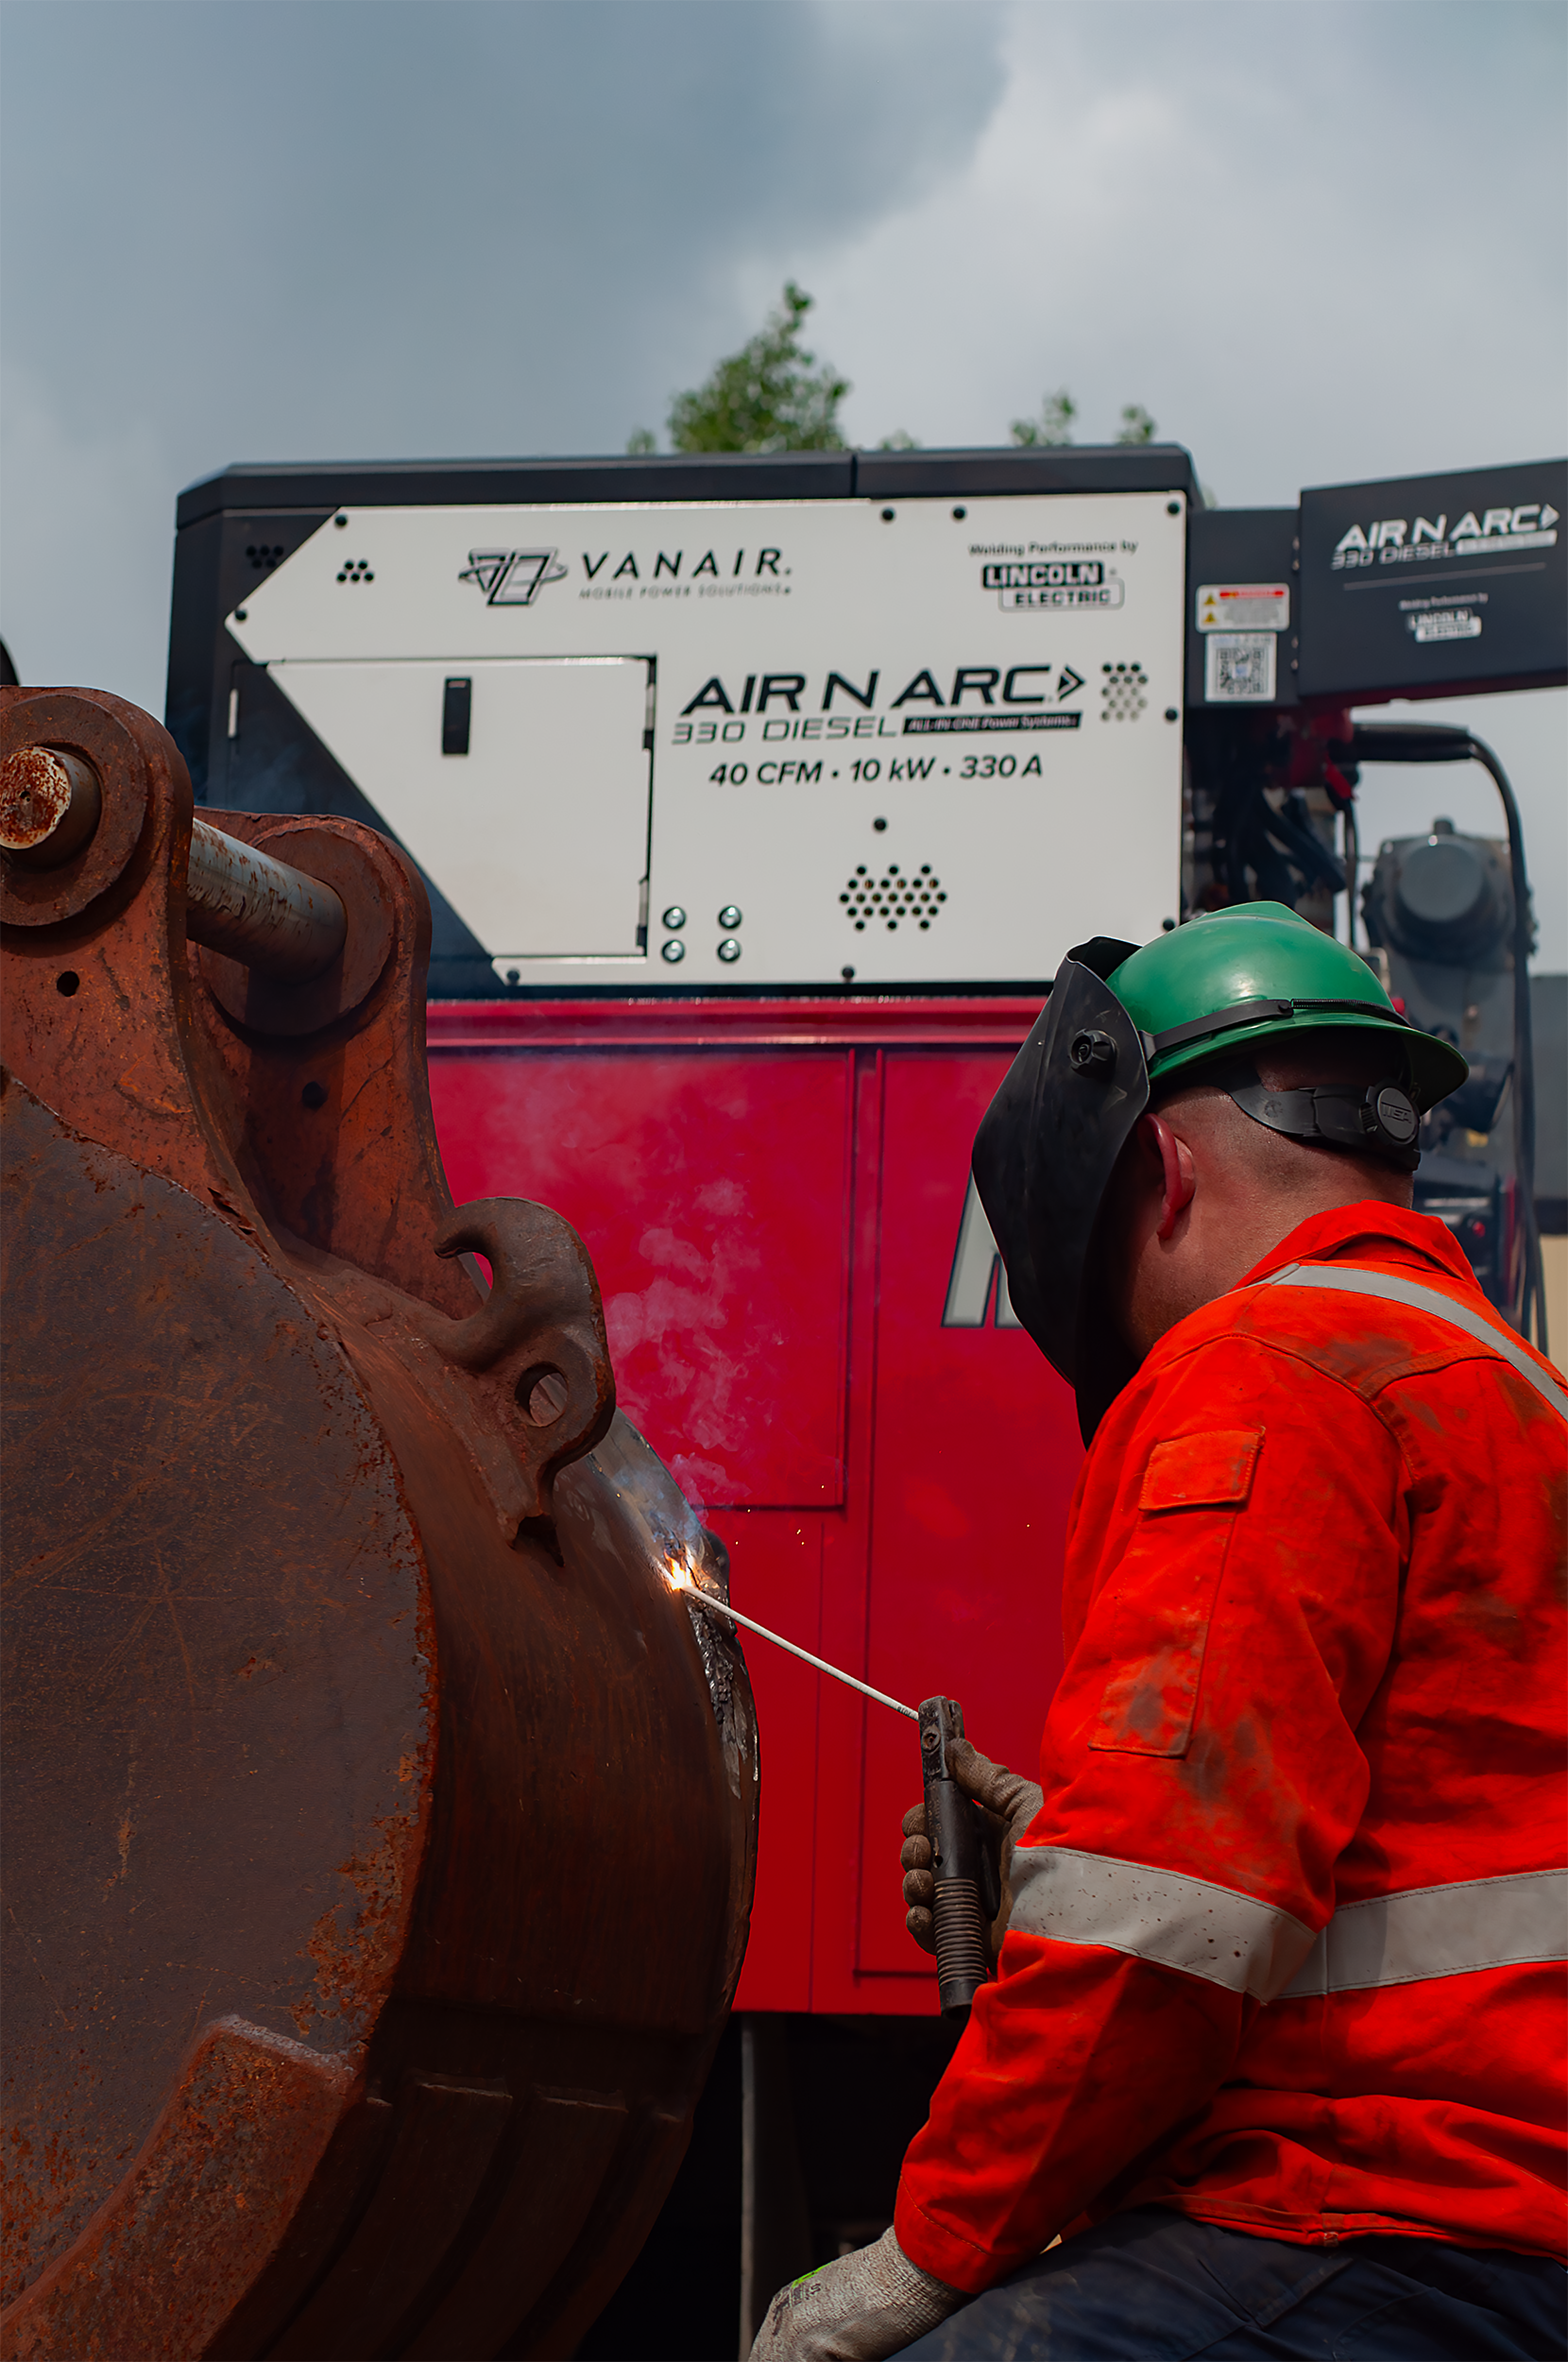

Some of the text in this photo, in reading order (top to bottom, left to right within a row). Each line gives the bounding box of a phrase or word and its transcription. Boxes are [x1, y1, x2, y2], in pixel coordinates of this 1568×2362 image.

[1336, 522, 1407, 553] AIR
[1411, 513, 1447, 544] N
[1449, 504, 1541, 541] ARC
[581, 547, 781, 580] VANAIR
[968, 539, 1139, 558] Welding Performance by
[1331, 550, 1374, 571] 330
[1379, 539, 1456, 565] DIESEL
[578, 581, 783, 600] MOBILE POWER SOLUTIONS
[986, 564, 1100, 587] LINCOLN
[1014, 589, 1111, 607] ELECTRIC
[680, 664, 1052, 717] AIR N ARC
[671, 715, 898, 746] 330 DIESEL
[708, 753, 1044, 786] 40 CFM 10 kW 330 A
